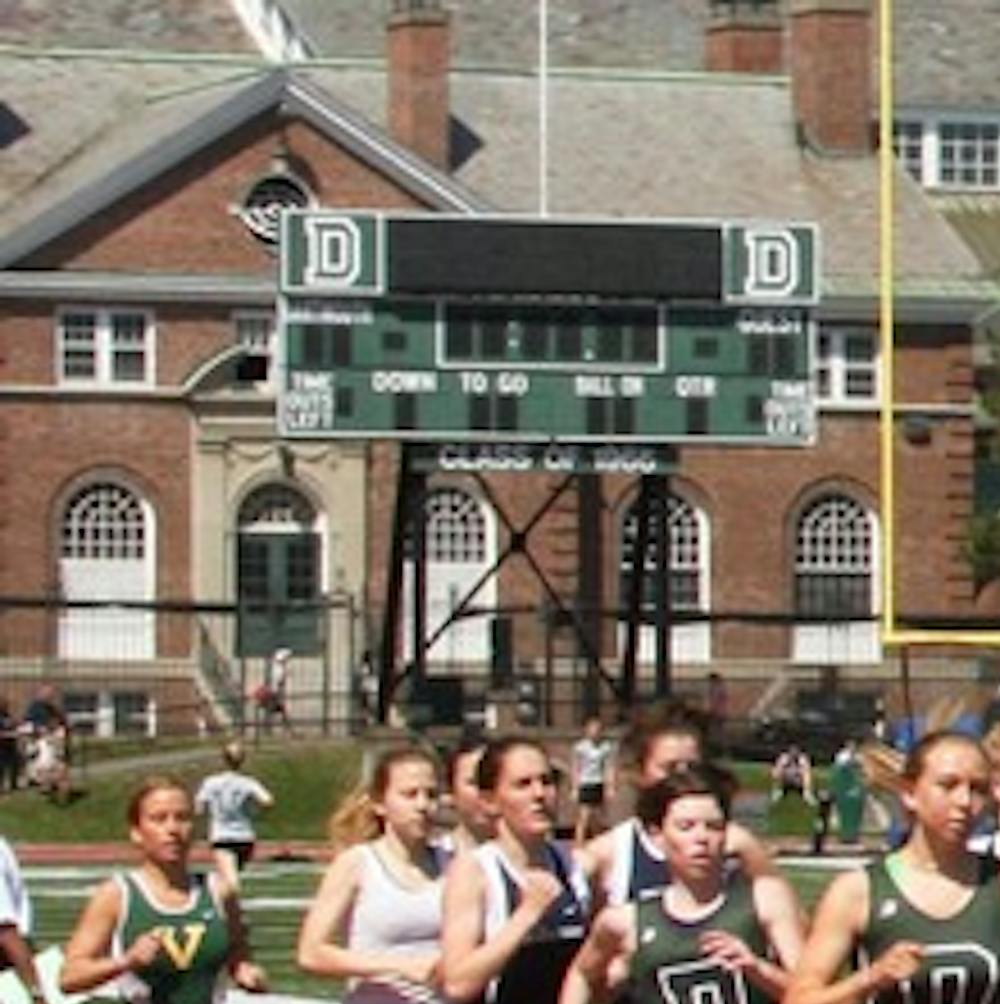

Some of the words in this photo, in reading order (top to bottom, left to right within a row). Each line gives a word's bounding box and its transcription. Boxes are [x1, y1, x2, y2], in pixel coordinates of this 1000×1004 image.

[303, 216, 361, 287] D
[744, 229, 799, 297] D
[371, 371, 438, 393] DOWN
[460, 372, 488, 393] TO
[496, 372, 530, 395] GO
[438, 444, 534, 470] CLASS
[157, 922, 207, 971] V
